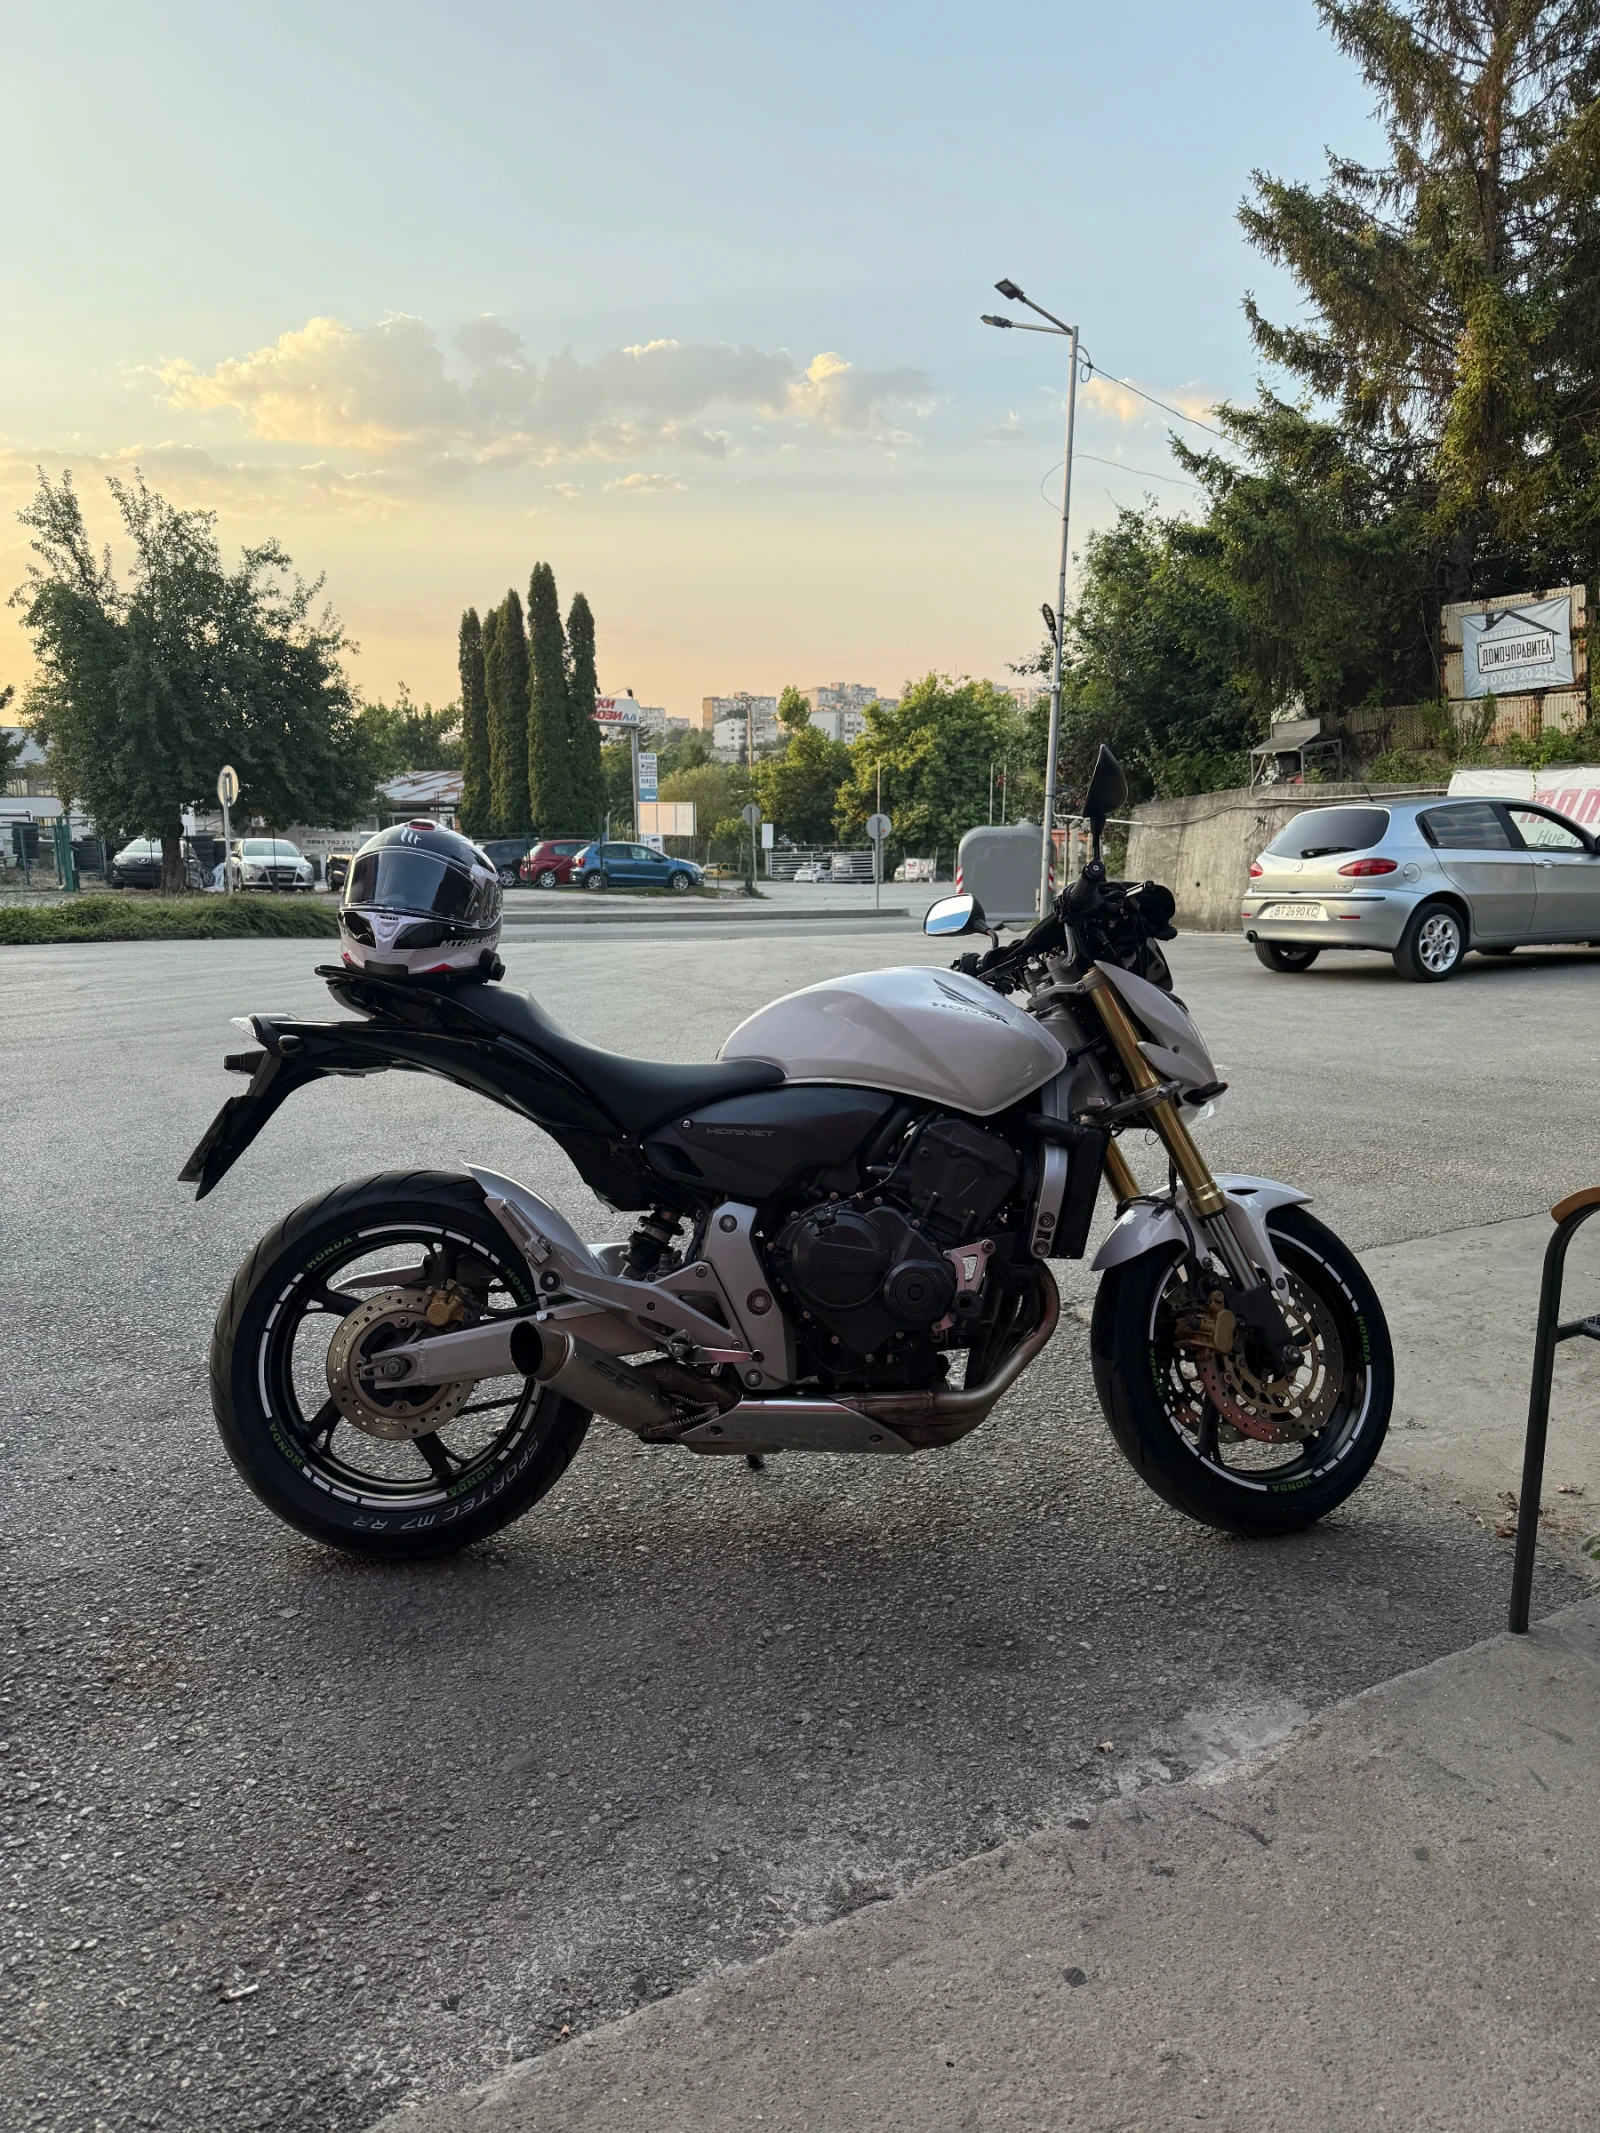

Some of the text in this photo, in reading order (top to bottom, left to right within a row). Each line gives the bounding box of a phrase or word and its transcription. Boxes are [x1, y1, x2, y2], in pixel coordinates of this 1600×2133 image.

[1482, 639, 1551, 667] ДОМОУПРАВИТЕЛ
[1490, 664, 1557, 685] 0700 20 215
[705, 1127, 775, 1137] HORNET
[306, 1236, 353, 1269] HONDA
[505, 1268, 531, 1303] HOND
[1356, 1315, 1372, 1362] HONDA
[1149, 1347, 1163, 1397] HONDA
[269, 1422, 303, 1466] HONDA
[443, 1432, 540, 1522] SPORTEC
[449, 1463, 496, 1497] HONDA
[1271, 1476, 1312, 1492] HONDA
[400, 1513, 437, 1531] M7
